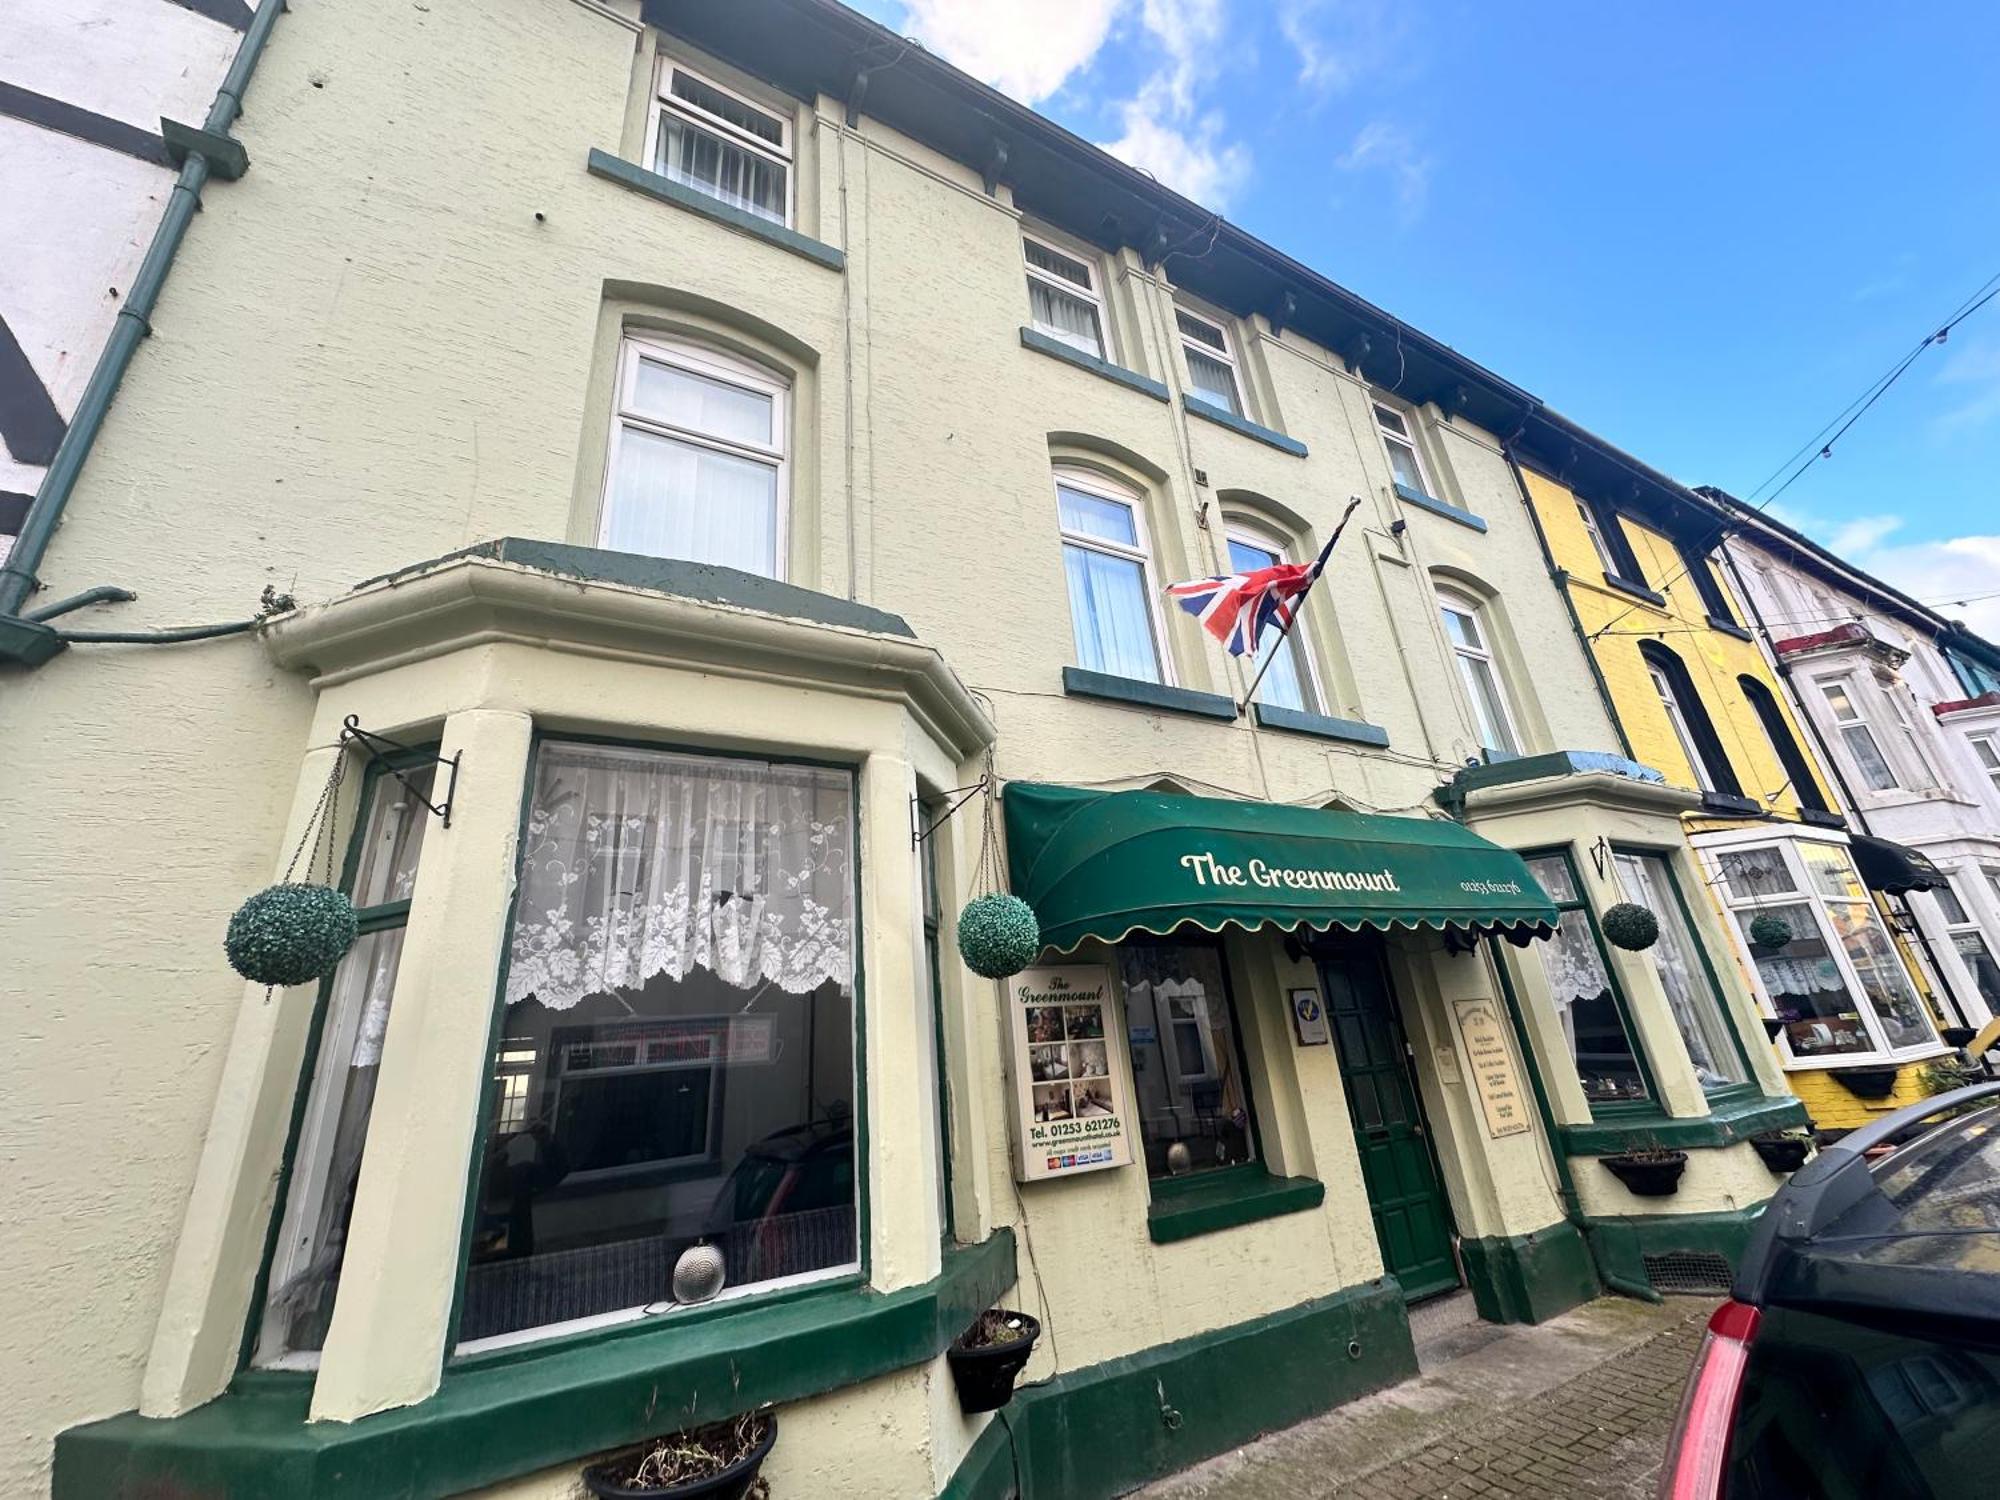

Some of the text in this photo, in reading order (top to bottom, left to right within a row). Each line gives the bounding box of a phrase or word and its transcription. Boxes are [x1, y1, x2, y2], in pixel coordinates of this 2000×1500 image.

[1180, 852, 1400, 891] The Greenmount
[1460, 880, 1489, 895] 01253
[1048, 976, 1070, 990] The
[1018, 985, 1104, 1003] Greenmount
[1030, 1117, 1121, 1139] Tel. 01253 621276
